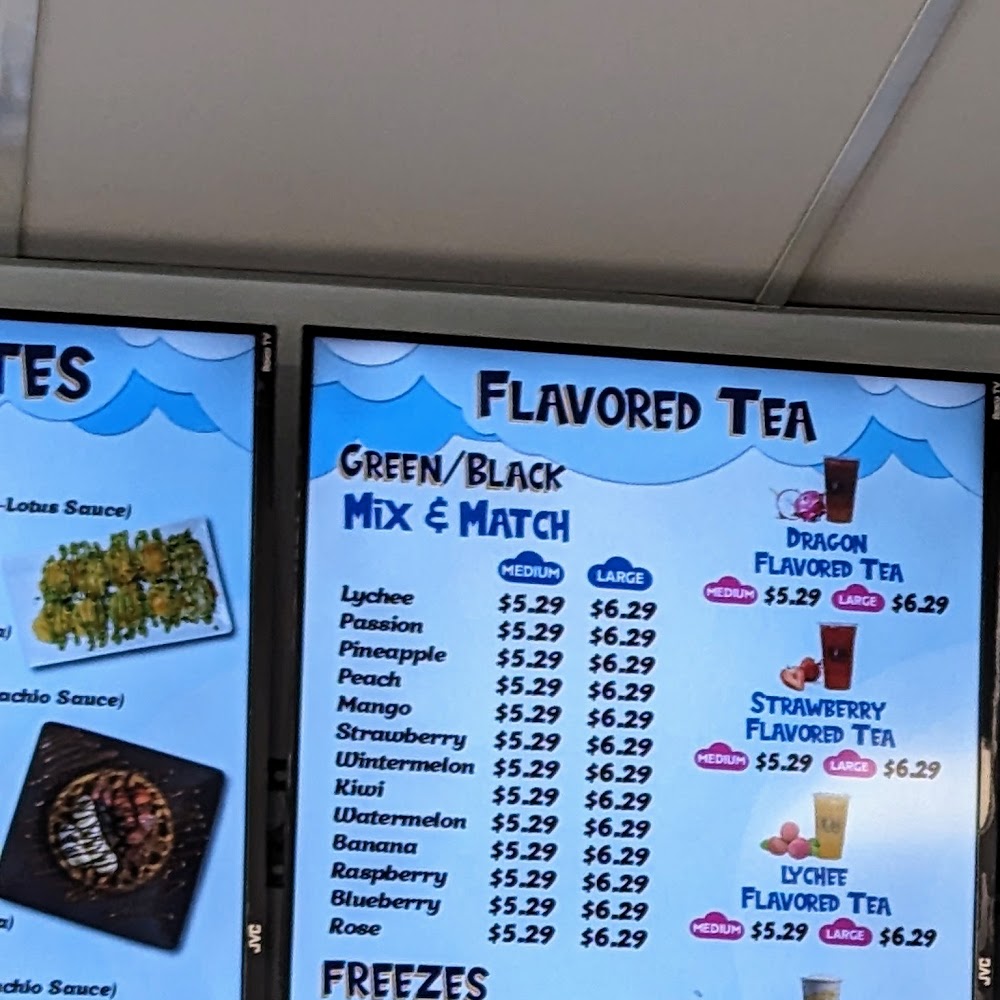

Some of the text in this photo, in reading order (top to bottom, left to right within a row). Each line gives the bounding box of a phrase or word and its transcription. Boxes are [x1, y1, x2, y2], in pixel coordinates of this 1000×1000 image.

[64, 500, 132, 519] Sauce)
[425, 497, 448, 532] &
[341, 586, 657, 621] Lychee $5.29 $6.29
[764, 587, 949, 614] $5.29 $6.29
[339, 613, 423, 634] Passion
[338, 641, 447, 666] Pineapple
[337, 668, 402, 688] Peach
[57, 690, 124, 709] Sauce)
[336, 696, 412, 718] Mango
[336, 723, 468, 750] Strawberry
[335, 752, 474, 775] Wintermelon
[334, 779, 385, 798] Kiwi
[333, 807, 467, 830] Watermelon
[332, 834, 418, 855] Banana
[331, 862, 448, 888] Raspberry
[331, 890, 441, 916] Blueberry
[329, 918, 382, 936] Rose
[248, 924, 262, 954] JVC
